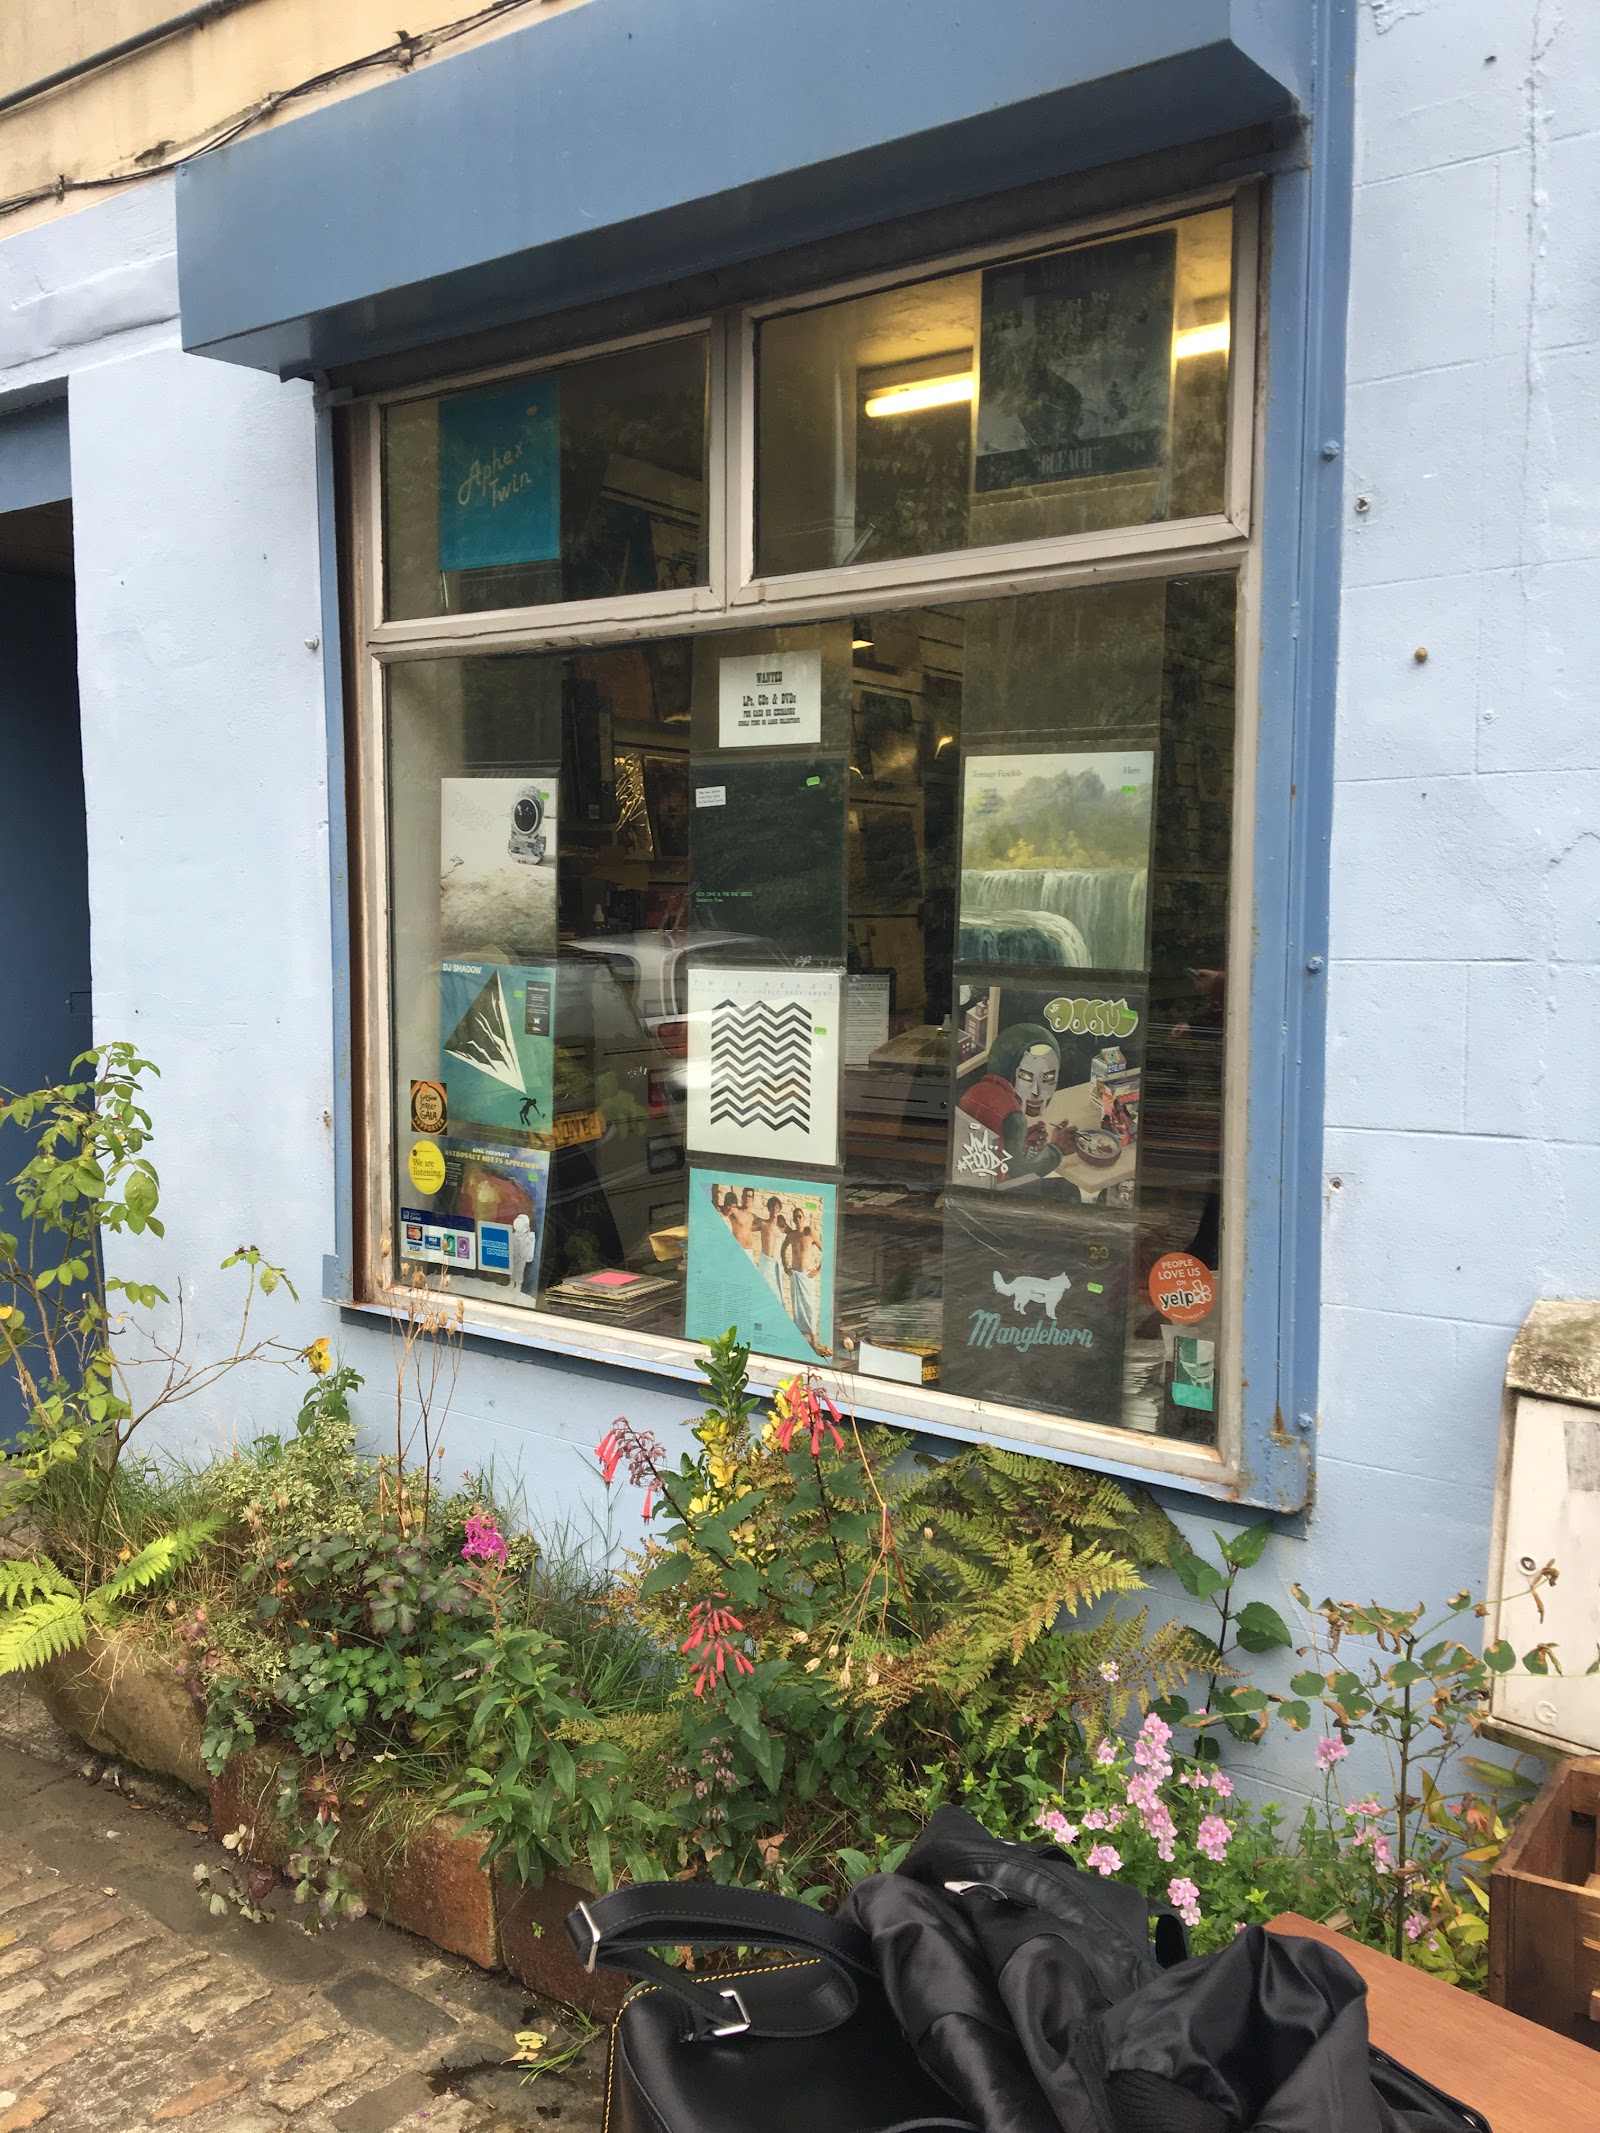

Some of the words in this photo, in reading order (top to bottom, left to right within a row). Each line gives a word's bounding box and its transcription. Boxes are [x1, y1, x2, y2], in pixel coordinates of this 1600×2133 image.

[458, 441, 522, 505] Aphex
[489, 471, 532, 508] Twin
[755, 671, 782, 683] WANTED
[758, 694, 769, 706] CDs
[772, 693, 778, 705] &
[781, 692, 796, 704] DVDs
[442, 963, 452, 972] DJ
[453, 964, 482, 975] SHADOW
[413, 1158, 423, 1168] We
[425, 1160, 435, 1168] are
[444, 1149, 481, 1161] ASTRONAUT
[481, 1154, 504, 1165] MEETS
[504, 1159, 540, 1170] APPLEMAN
[482, 1239, 508, 1250] AMERICAN
[487, 1247, 509, 1258] EXPRESS
[1162, 1258, 1194, 1269] PEOPLE
[1158, 1269, 1186, 1280] LOVE
[1187, 1267, 1201, 1277] US
[1158, 1288, 1196, 1311] yelp
[967, 1309, 1094, 1353] Manglehorn
